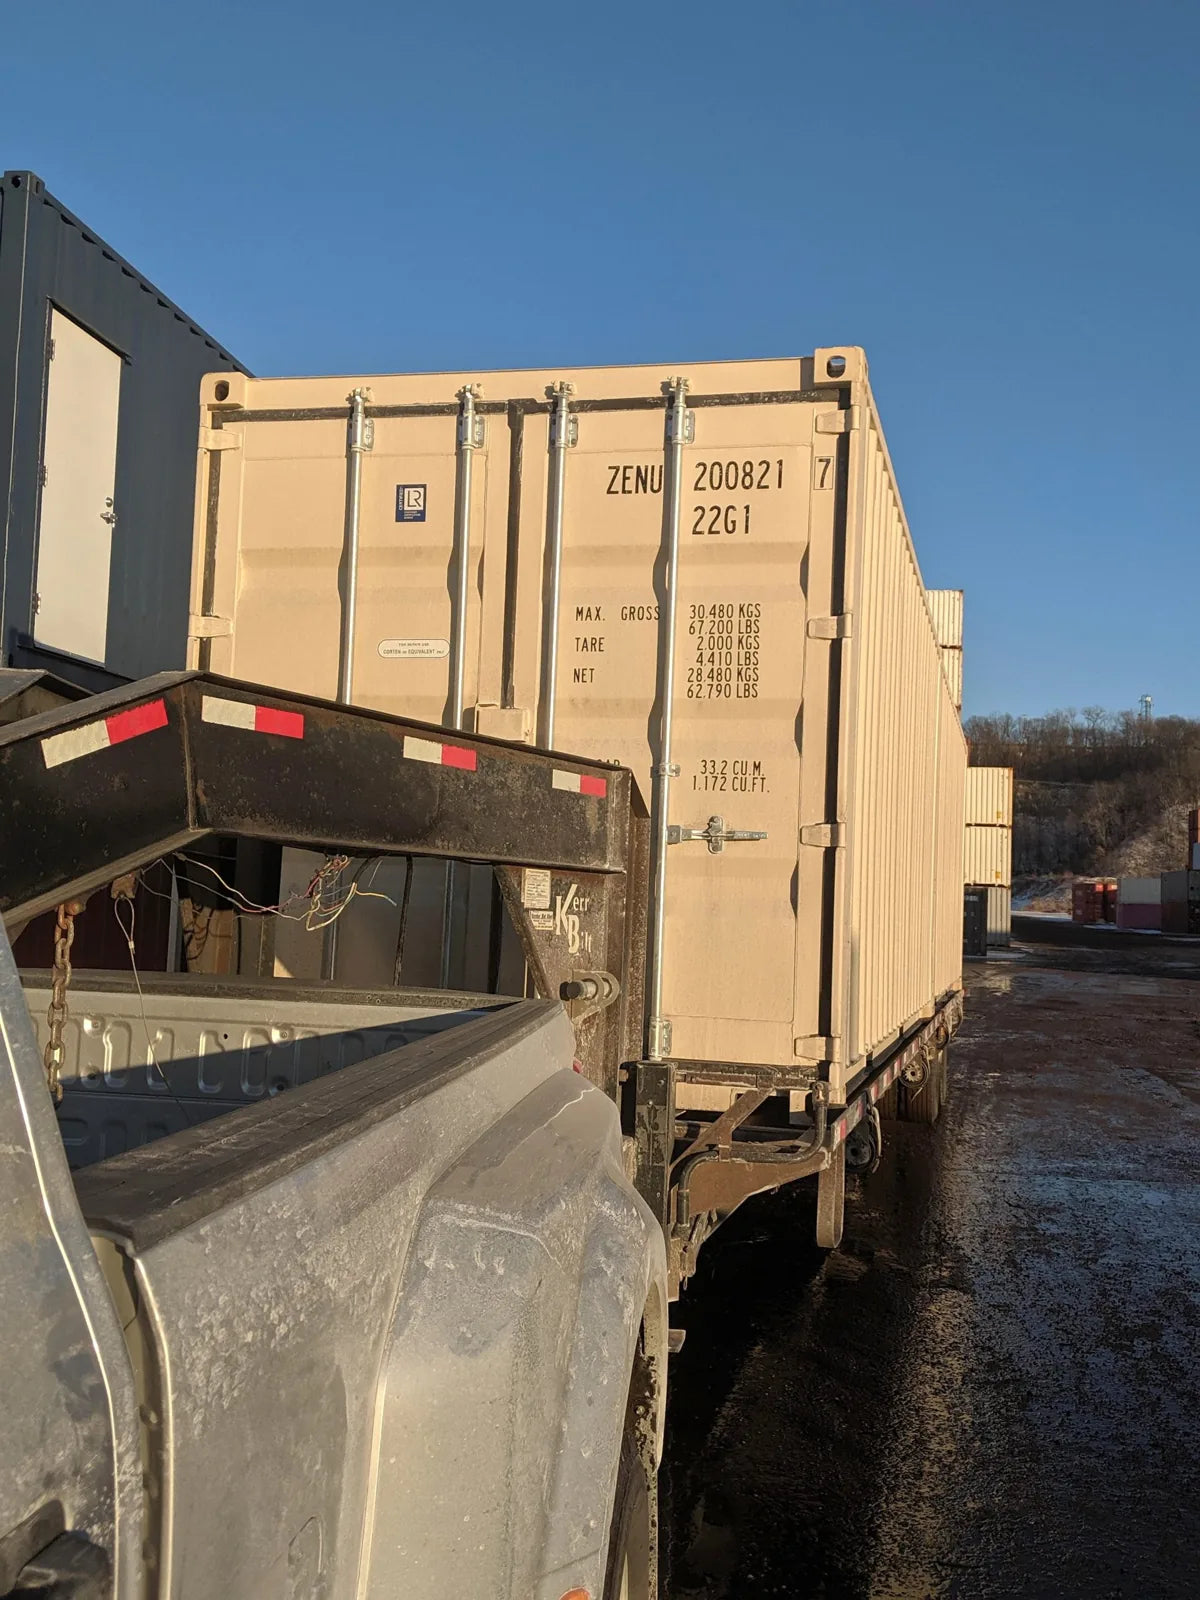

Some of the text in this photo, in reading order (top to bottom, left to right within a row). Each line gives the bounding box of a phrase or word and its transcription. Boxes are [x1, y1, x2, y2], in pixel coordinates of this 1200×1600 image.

[606, 458, 831, 494] ZENU 200821 7
[407, 490, 422, 508] LR
[692, 504, 750, 535] 22G1
[575, 606, 606, 621] MAX.
[621, 605, 661, 621] GROSS
[739, 603, 761, 618] KGS
[738, 619, 760, 634] LBS
[575, 637, 605, 652] TARE
[738, 635, 760, 650] KGS
[737, 651, 759, 666] LBS
[573, 668, 595, 683] NET
[737, 667, 759, 682] KGS
[736, 683, 758, 698] LBS
[700, 759, 728, 775] 33.2
[555, 884, 590, 935] Kerr
[567, 914, 592, 953] Bilt
